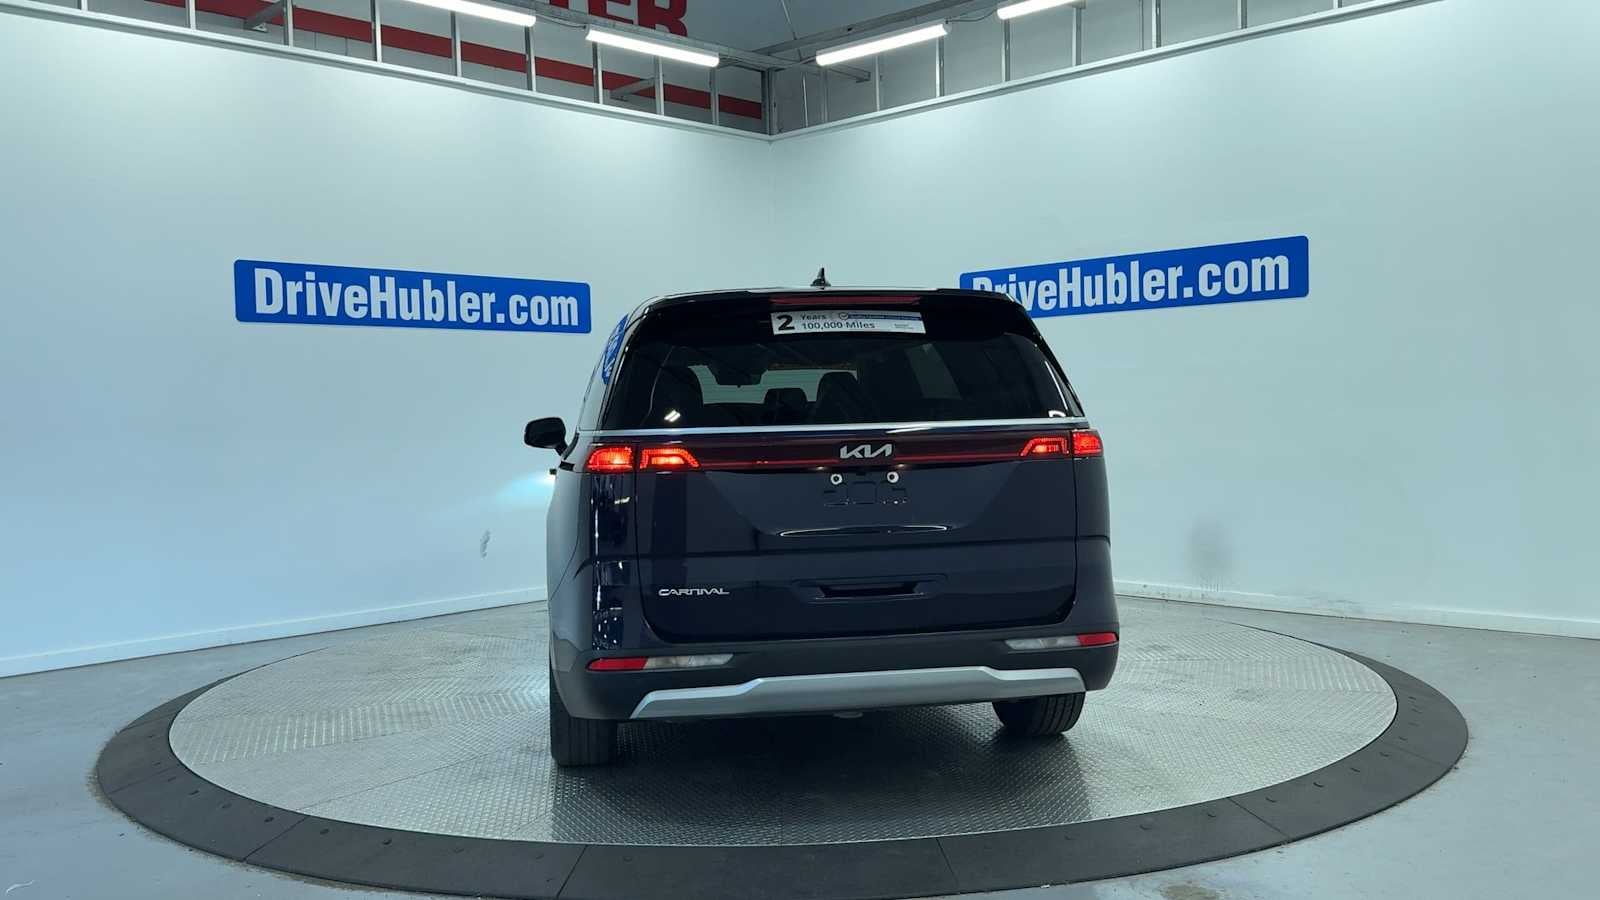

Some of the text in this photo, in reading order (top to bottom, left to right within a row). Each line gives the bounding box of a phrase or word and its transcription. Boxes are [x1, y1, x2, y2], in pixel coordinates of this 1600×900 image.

[254, 267, 579, 326] DriveHubler.com
[776, 314, 795, 331] 2
[801, 312, 827, 320] Years
[802, 320, 876, 331] 100,000 Miles
[840, 443, 892, 458] KIA
[658, 588, 730, 596] CARNIVAL
